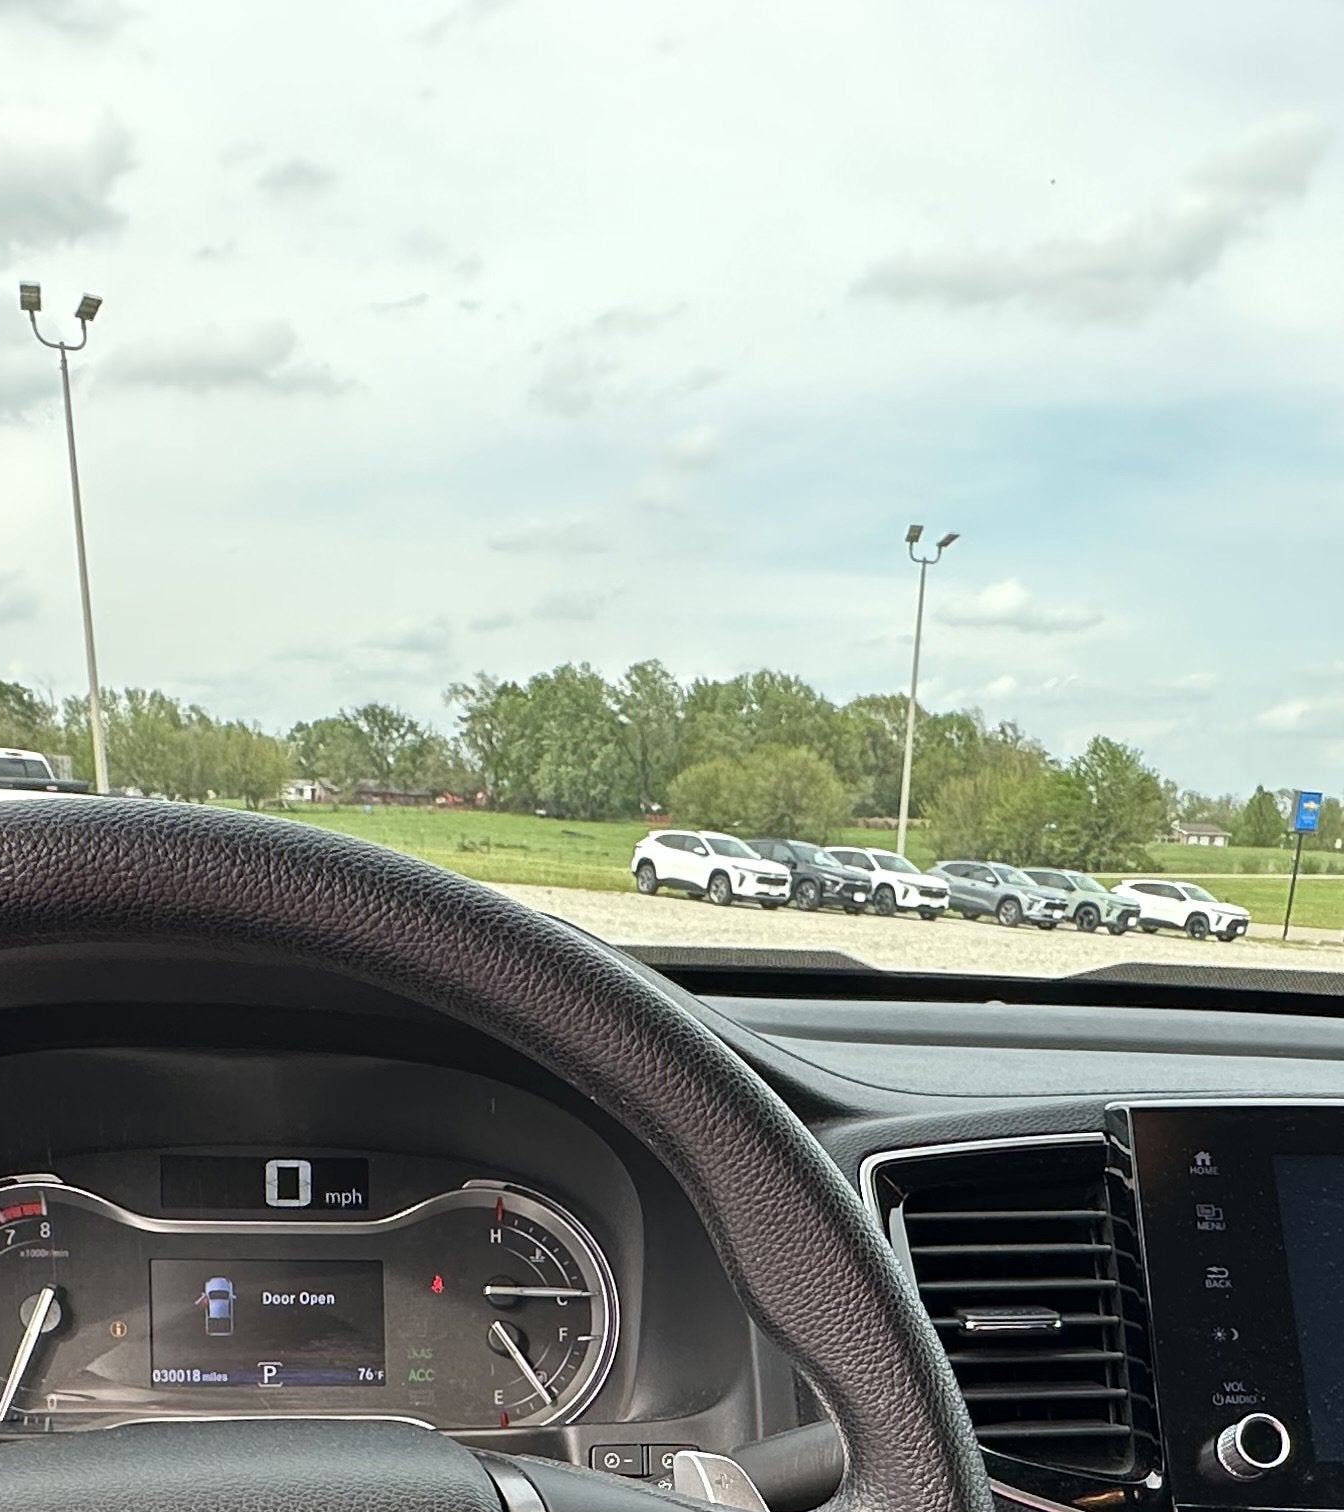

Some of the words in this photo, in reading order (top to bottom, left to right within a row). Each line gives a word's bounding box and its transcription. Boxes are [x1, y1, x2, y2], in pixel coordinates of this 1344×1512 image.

[1189, 1166, 1219, 1176] HOME
[265, 1159, 311, 1207] 0
[325, 1188, 362, 1208] mph
[40, 1222, 51, 1239] 8
[1196, 1221, 1226, 1231] MENU
[5, 1229, 16, 1246] 7
[490, 1229, 502, 1243] H
[1205, 1279, 1233, 1289] BACK
[262, 1291, 296, 1305] Door
[299, 1291, 336, 1307] Open
[558, 1328, 569, 1342] F
[152, 1369, 201, 1383] 030018
[202, 1372, 228, 1382] miles
[263, 1366, 278, 1384] P
[408, 1370, 435, 1382] ACC
[1223, 1382, 1247, 1392] VOL
[47, 1395, 57, 1411] 0
[494, 1390, 504, 1405] E
[1225, 1395, 1257, 1405] AUDIO
